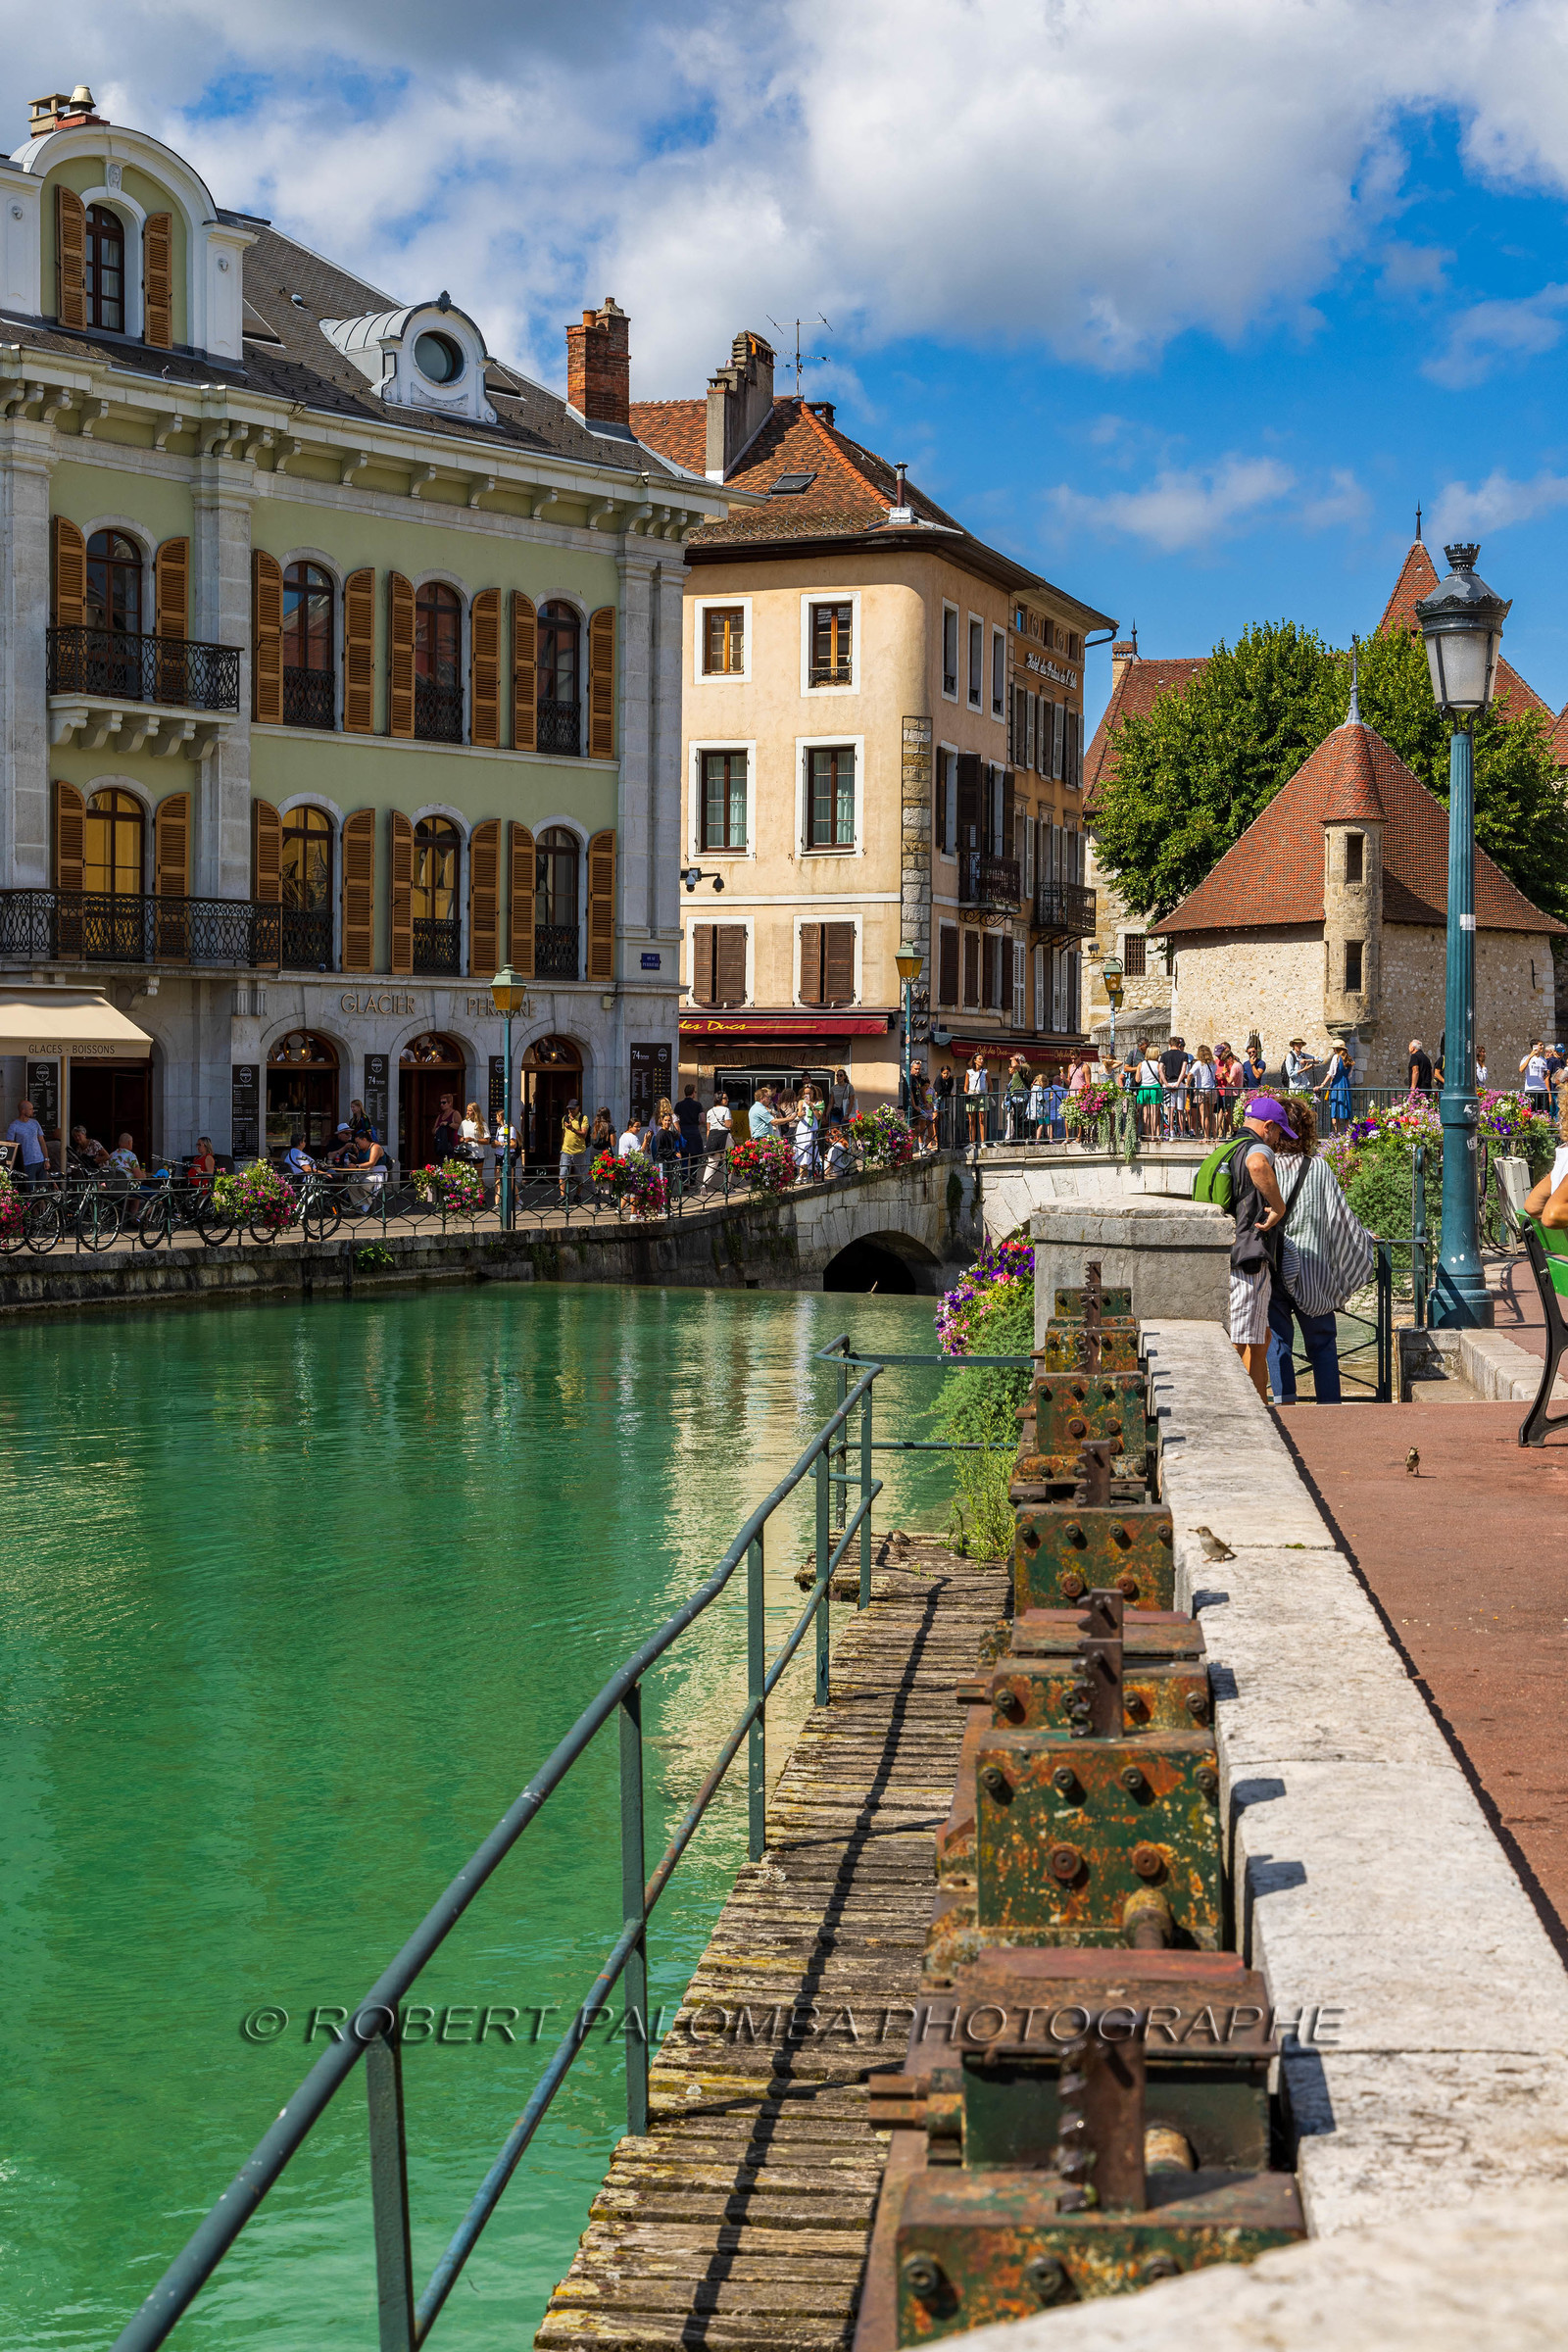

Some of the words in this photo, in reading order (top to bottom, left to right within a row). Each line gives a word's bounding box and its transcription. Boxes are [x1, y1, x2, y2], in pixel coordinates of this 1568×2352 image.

[340, 993, 416, 1015] GLACIER
[466, 997, 537, 1018] PERRE
[707, 1020, 746, 1031] Ducs
[28, 1044, 63, 1054] GLACES
[72, 1045, 116, 1054] BOISSONS
[632, 1051, 640, 1059] 74
[368, 1076, 376, 1085] 74
